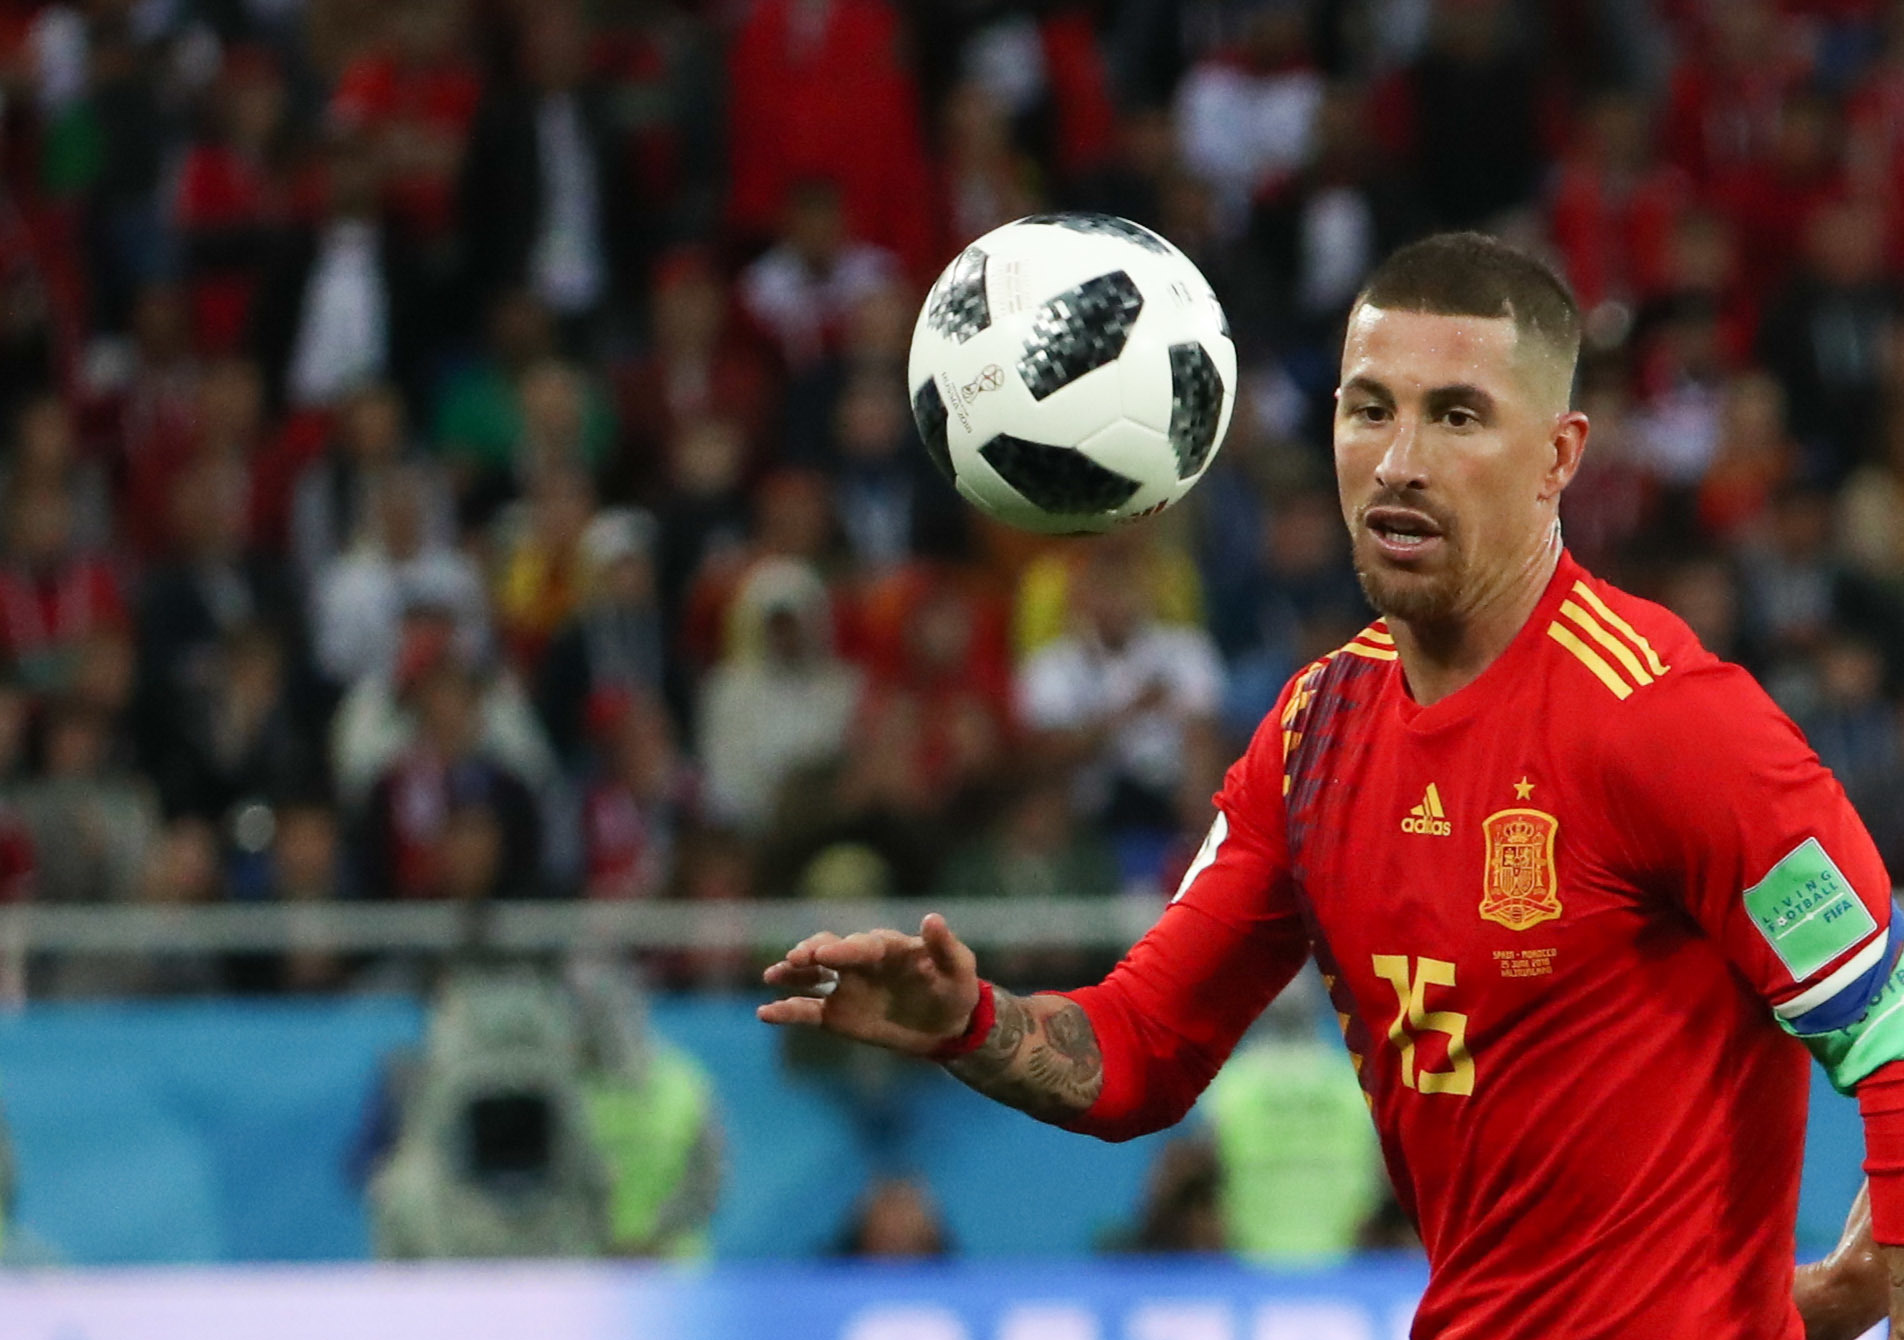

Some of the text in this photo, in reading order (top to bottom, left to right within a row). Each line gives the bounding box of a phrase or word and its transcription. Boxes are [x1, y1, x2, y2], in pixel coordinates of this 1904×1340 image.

[1401, 816, 1452, 836] adidas
[1762, 869, 1833, 924] LIVING
[1823, 899, 1854, 924] FIFA
[1372, 954, 1476, 1097] 15
